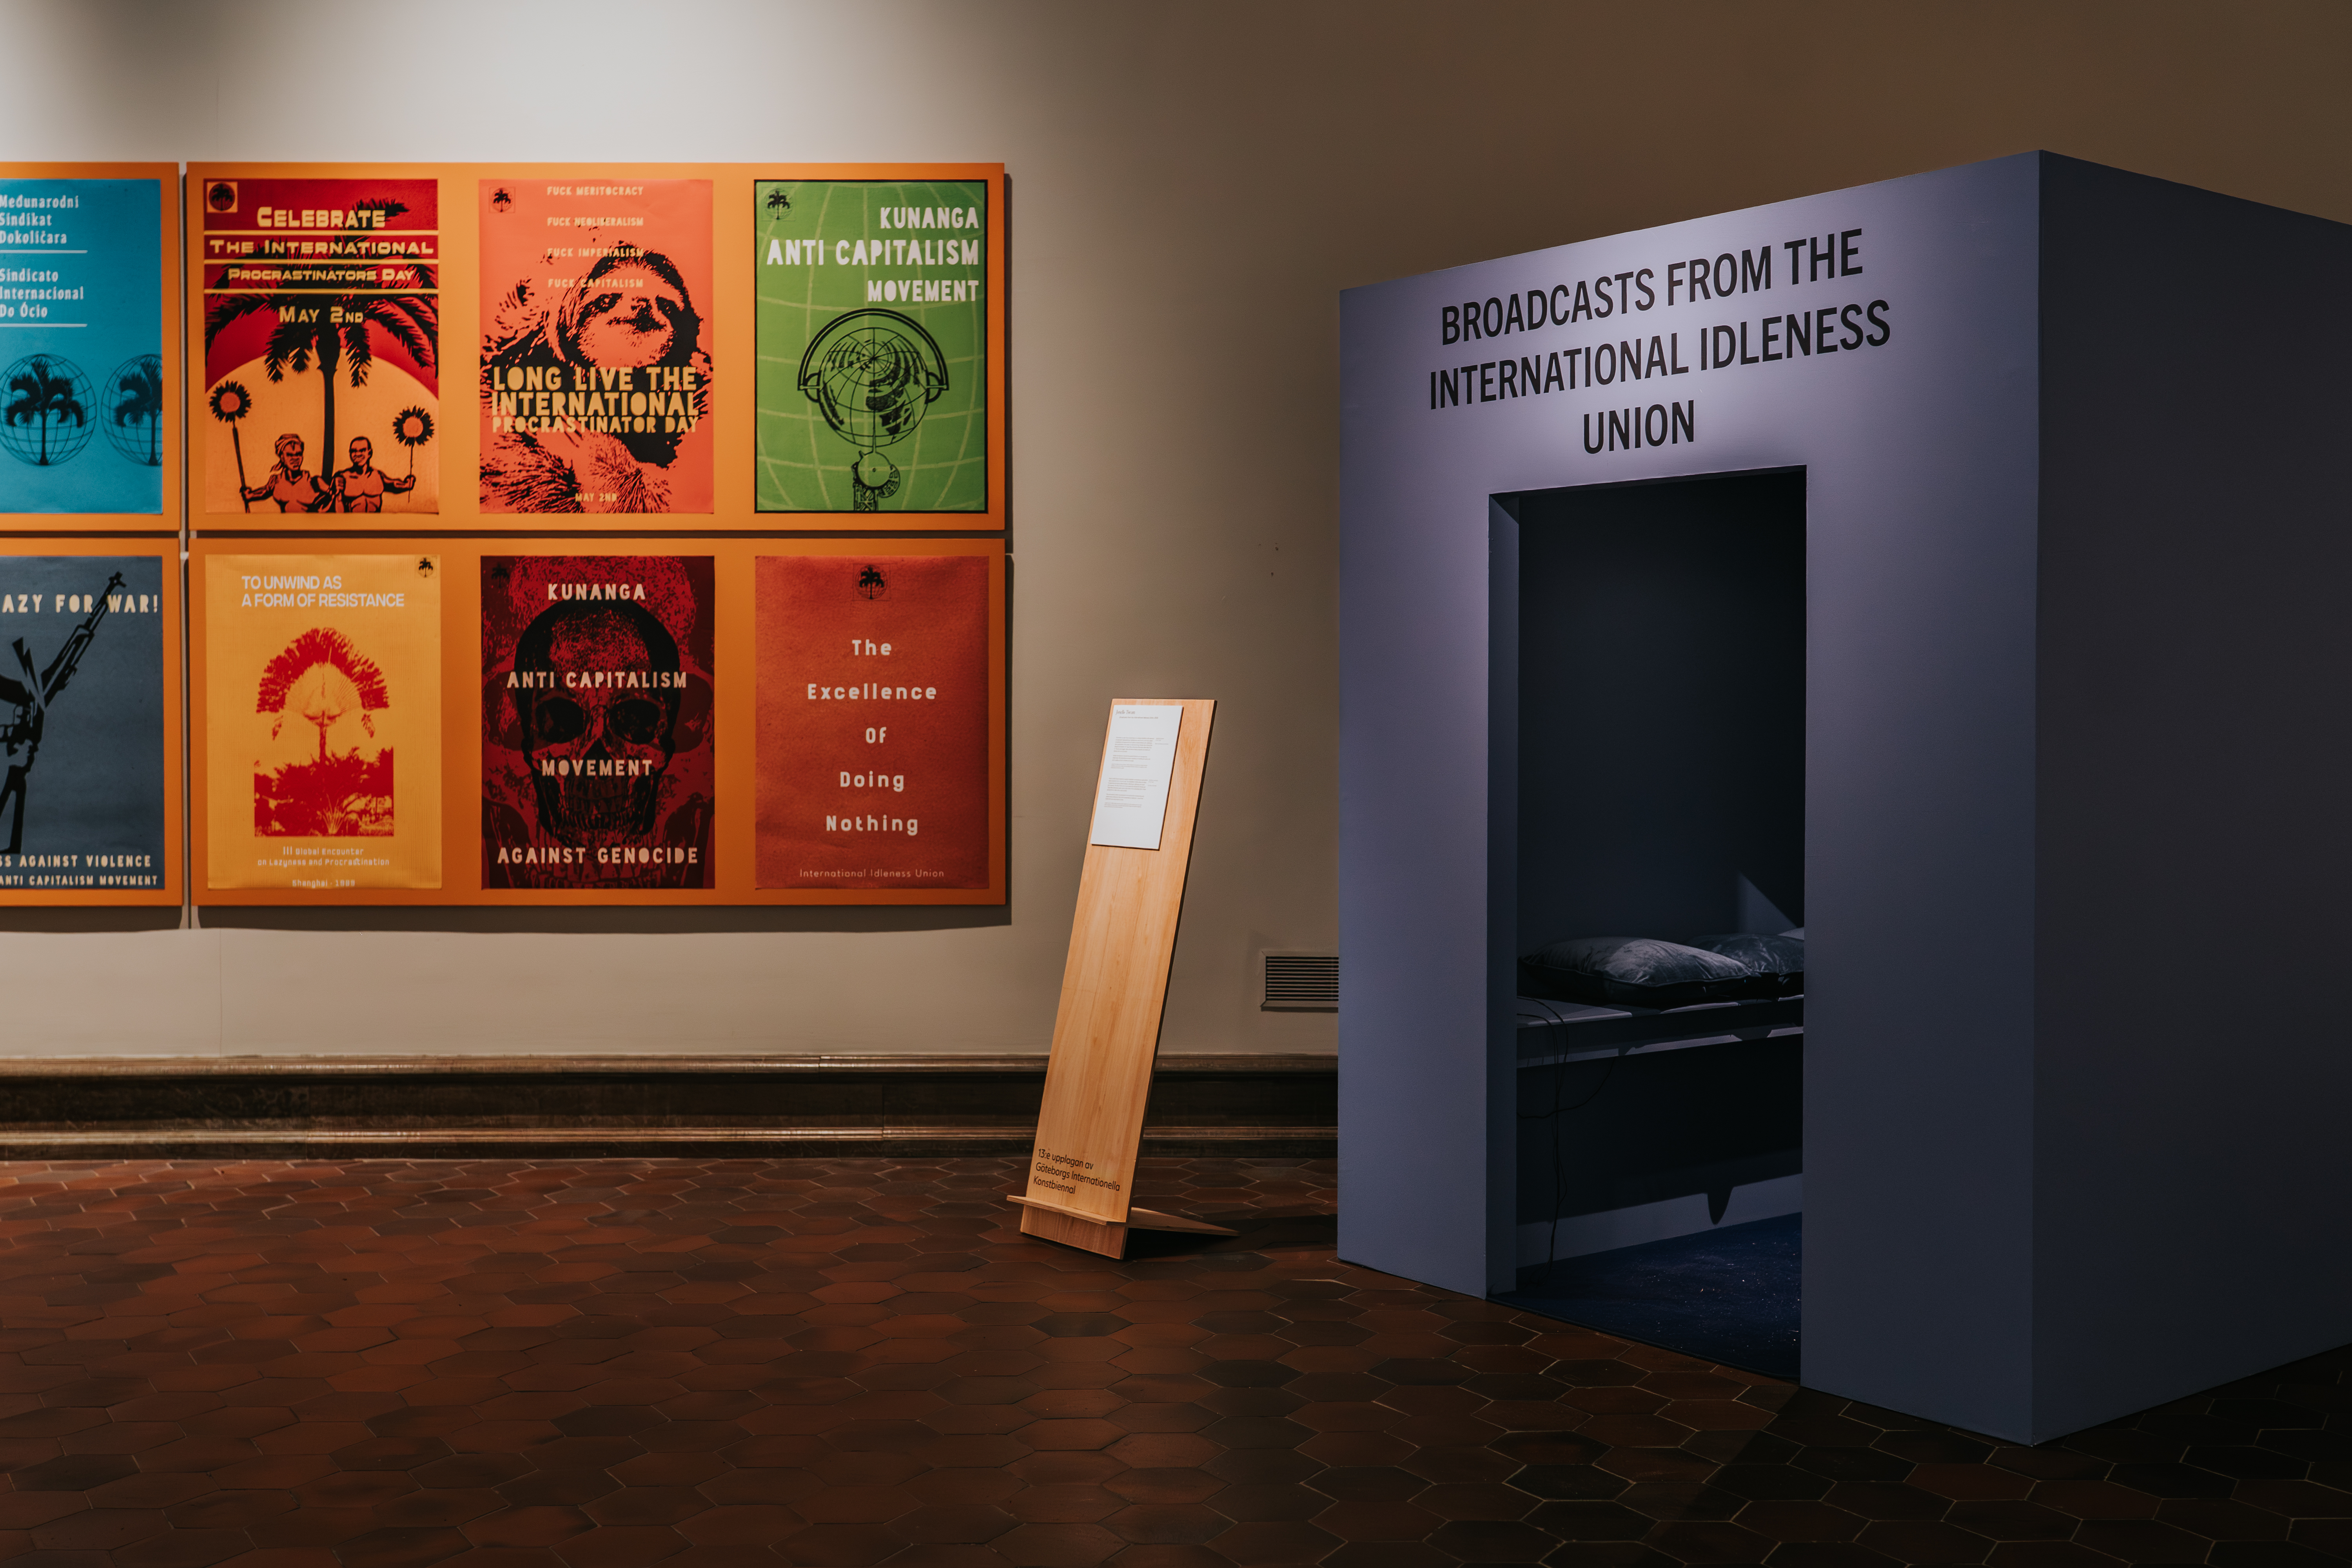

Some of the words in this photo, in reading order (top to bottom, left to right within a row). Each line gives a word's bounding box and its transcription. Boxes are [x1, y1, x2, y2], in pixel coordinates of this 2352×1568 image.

[547, 186, 572, 196] FUCK
[576, 186, 643, 196] MERITOCRACY
[0, 212, 52, 226] Sindikat
[257, 207, 385, 227] CELEBRATE
[547, 217, 571, 226] FUCK
[574, 217, 644, 226] NEOLIBERALISM
[880, 207, 978, 229] KUNANGA
[0, 230, 67, 244] Dokoličara
[210, 239, 254, 254] THE
[265, 239, 434, 254] INTERNATIONAL
[547, 248, 573, 257] FUCK
[578, 248, 644, 257] IMPERIALISM
[767, 240, 824, 265] ANTI
[836, 240, 978, 265] CAPITALISM
[0, 268, 58, 282] Sindicato
[228, 268, 377, 281] PROCRASTINATORS
[382, 268, 414, 281] DAY
[548, 279, 575, 288] FUCK
[580, 279, 643, 288] CAPITALISM
[868, 280, 978, 301] MOVEMENT
[1441, 267, 1655, 346] BROADCASTS
[1668, 244, 1772, 307] FROM
[1784, 227, 1863, 285] THE
[0, 286, 84, 300] Internacional
[0, 304, 14, 318] Do
[20, 301, 48, 318] Ócio
[279, 306, 319, 323] MAY
[330, 306, 363, 323] 2ND
[1430, 332, 1689, 410] INTERNATIONAL
[1700, 299, 1891, 371] IDLENESS
[494, 367, 562, 391] LONG
[575, 367, 633, 391] LIVE
[646, 367, 697, 391] THE
[492, 392, 699, 416] INTERNATIONAL
[492, 416, 656, 433] PROCRASTINATOR
[665, 416, 699, 433] DAY
[1583, 399, 1695, 454] UNION
[575, 493, 594, 502] MAY
[599, 493, 617, 502] 2ND
[241, 576, 261, 590] TO
[264, 576, 320, 590] UNWIND
[323, 576, 342, 590] AS
[241, 593, 252, 607] A
[255, 593, 294, 607] FORM
[297, 593, 316, 607] OF
[319, 593, 405, 607] RESISTANCE
[548, 583, 646, 601] KUNANGA
[2, 594, 42, 613] AZY
[56, 594, 93, 613] FOR
[107, 594, 158, 613] WAR!
[852, 639, 892, 656] The
[507, 671, 554, 688] ANTI
[566, 671, 687, 688] CAPITALISM
[807, 682, 937, 700] Excellence
[542, 759, 652, 776] MOVEMENT
[840, 770, 904, 792] Doing
[826, 814, 918, 836] Nothing
[296, 847, 319, 855] Global
[497, 847, 586, 864] AGAINST
[597, 847, 698, 864] GENOCIDE
[19, 855, 78, 867] AGAINST
[86, 855, 151, 867] VIOLENCE
[0, 875, 23, 886] ANTI
[29, 875, 93, 886] CAPITALISM
[100, 875, 157, 886] MOVEMENT
[799, 869, 866, 878] International
[870, 869, 911, 878] Idleness
[915, 869, 944, 878] Union
[292, 879, 327, 889] Shanghai
[1038, 1148, 1051, 1160] 13:e
[1052, 1154, 1083, 1168] upplagan
[1033, 1175, 1076, 1194] Konstbiennal
[1036, 1162, 1070, 1180] Göteborgs
[1071, 1171, 1120, 1191] Internationella
